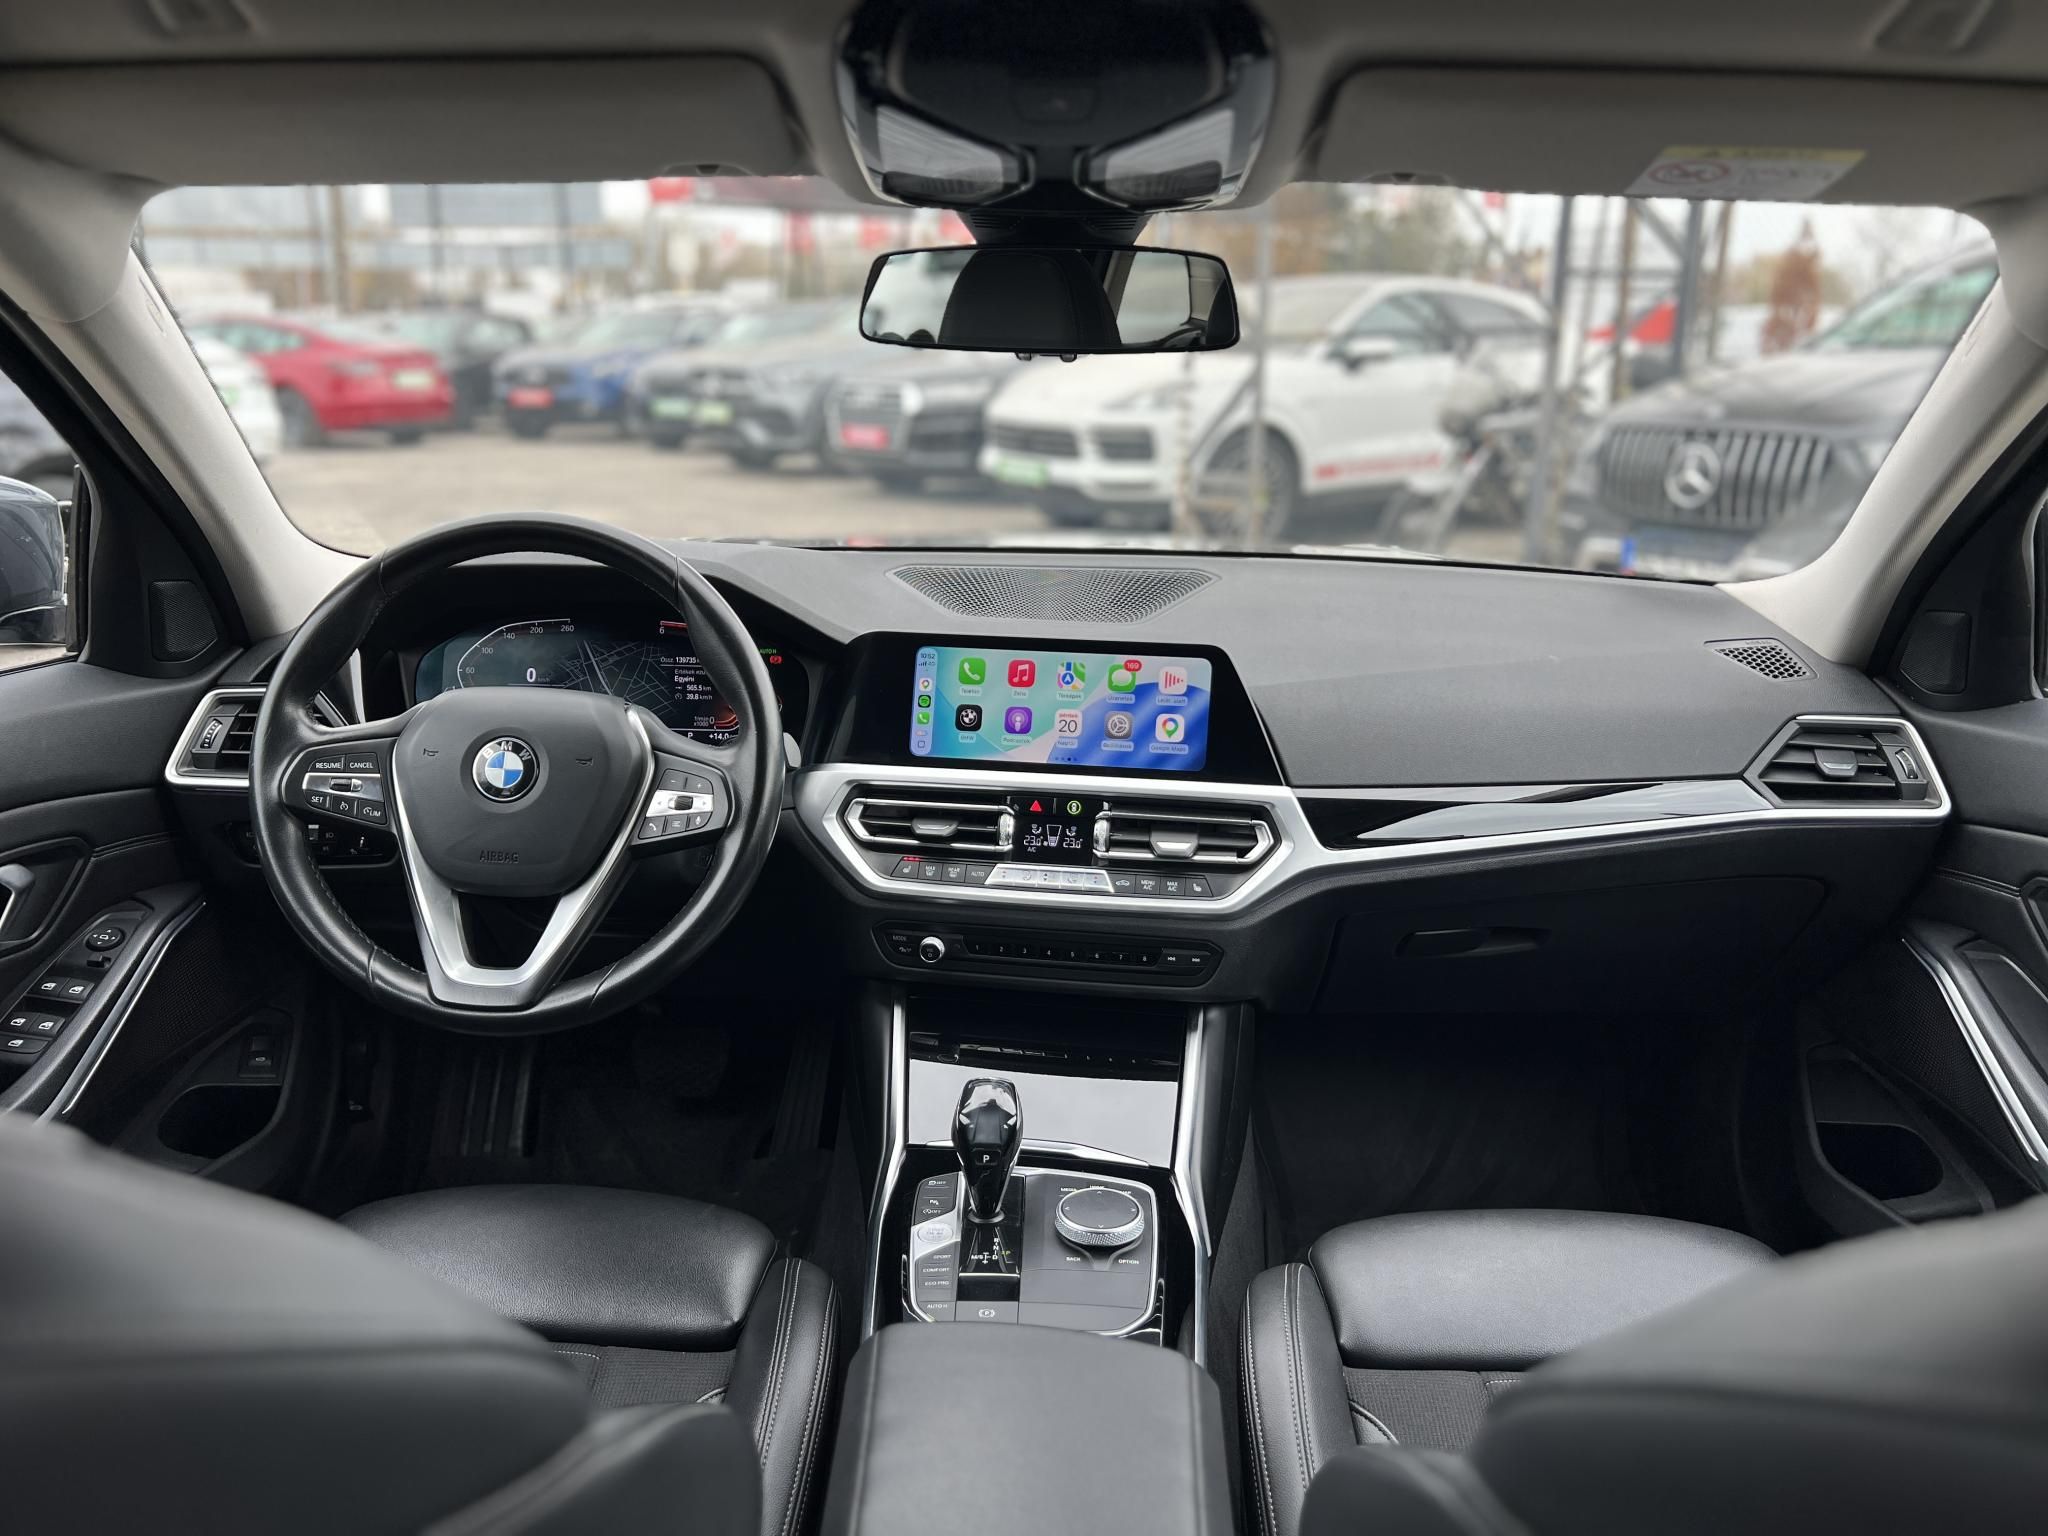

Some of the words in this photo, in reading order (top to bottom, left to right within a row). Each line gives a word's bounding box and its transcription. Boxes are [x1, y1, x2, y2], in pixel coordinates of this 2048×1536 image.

[526, 667, 537, 682] 0
[1058, 720, 1078, 733] 20
[480, 850, 520, 863] AIRBAG
[983, 1154, 990, 1163] P
